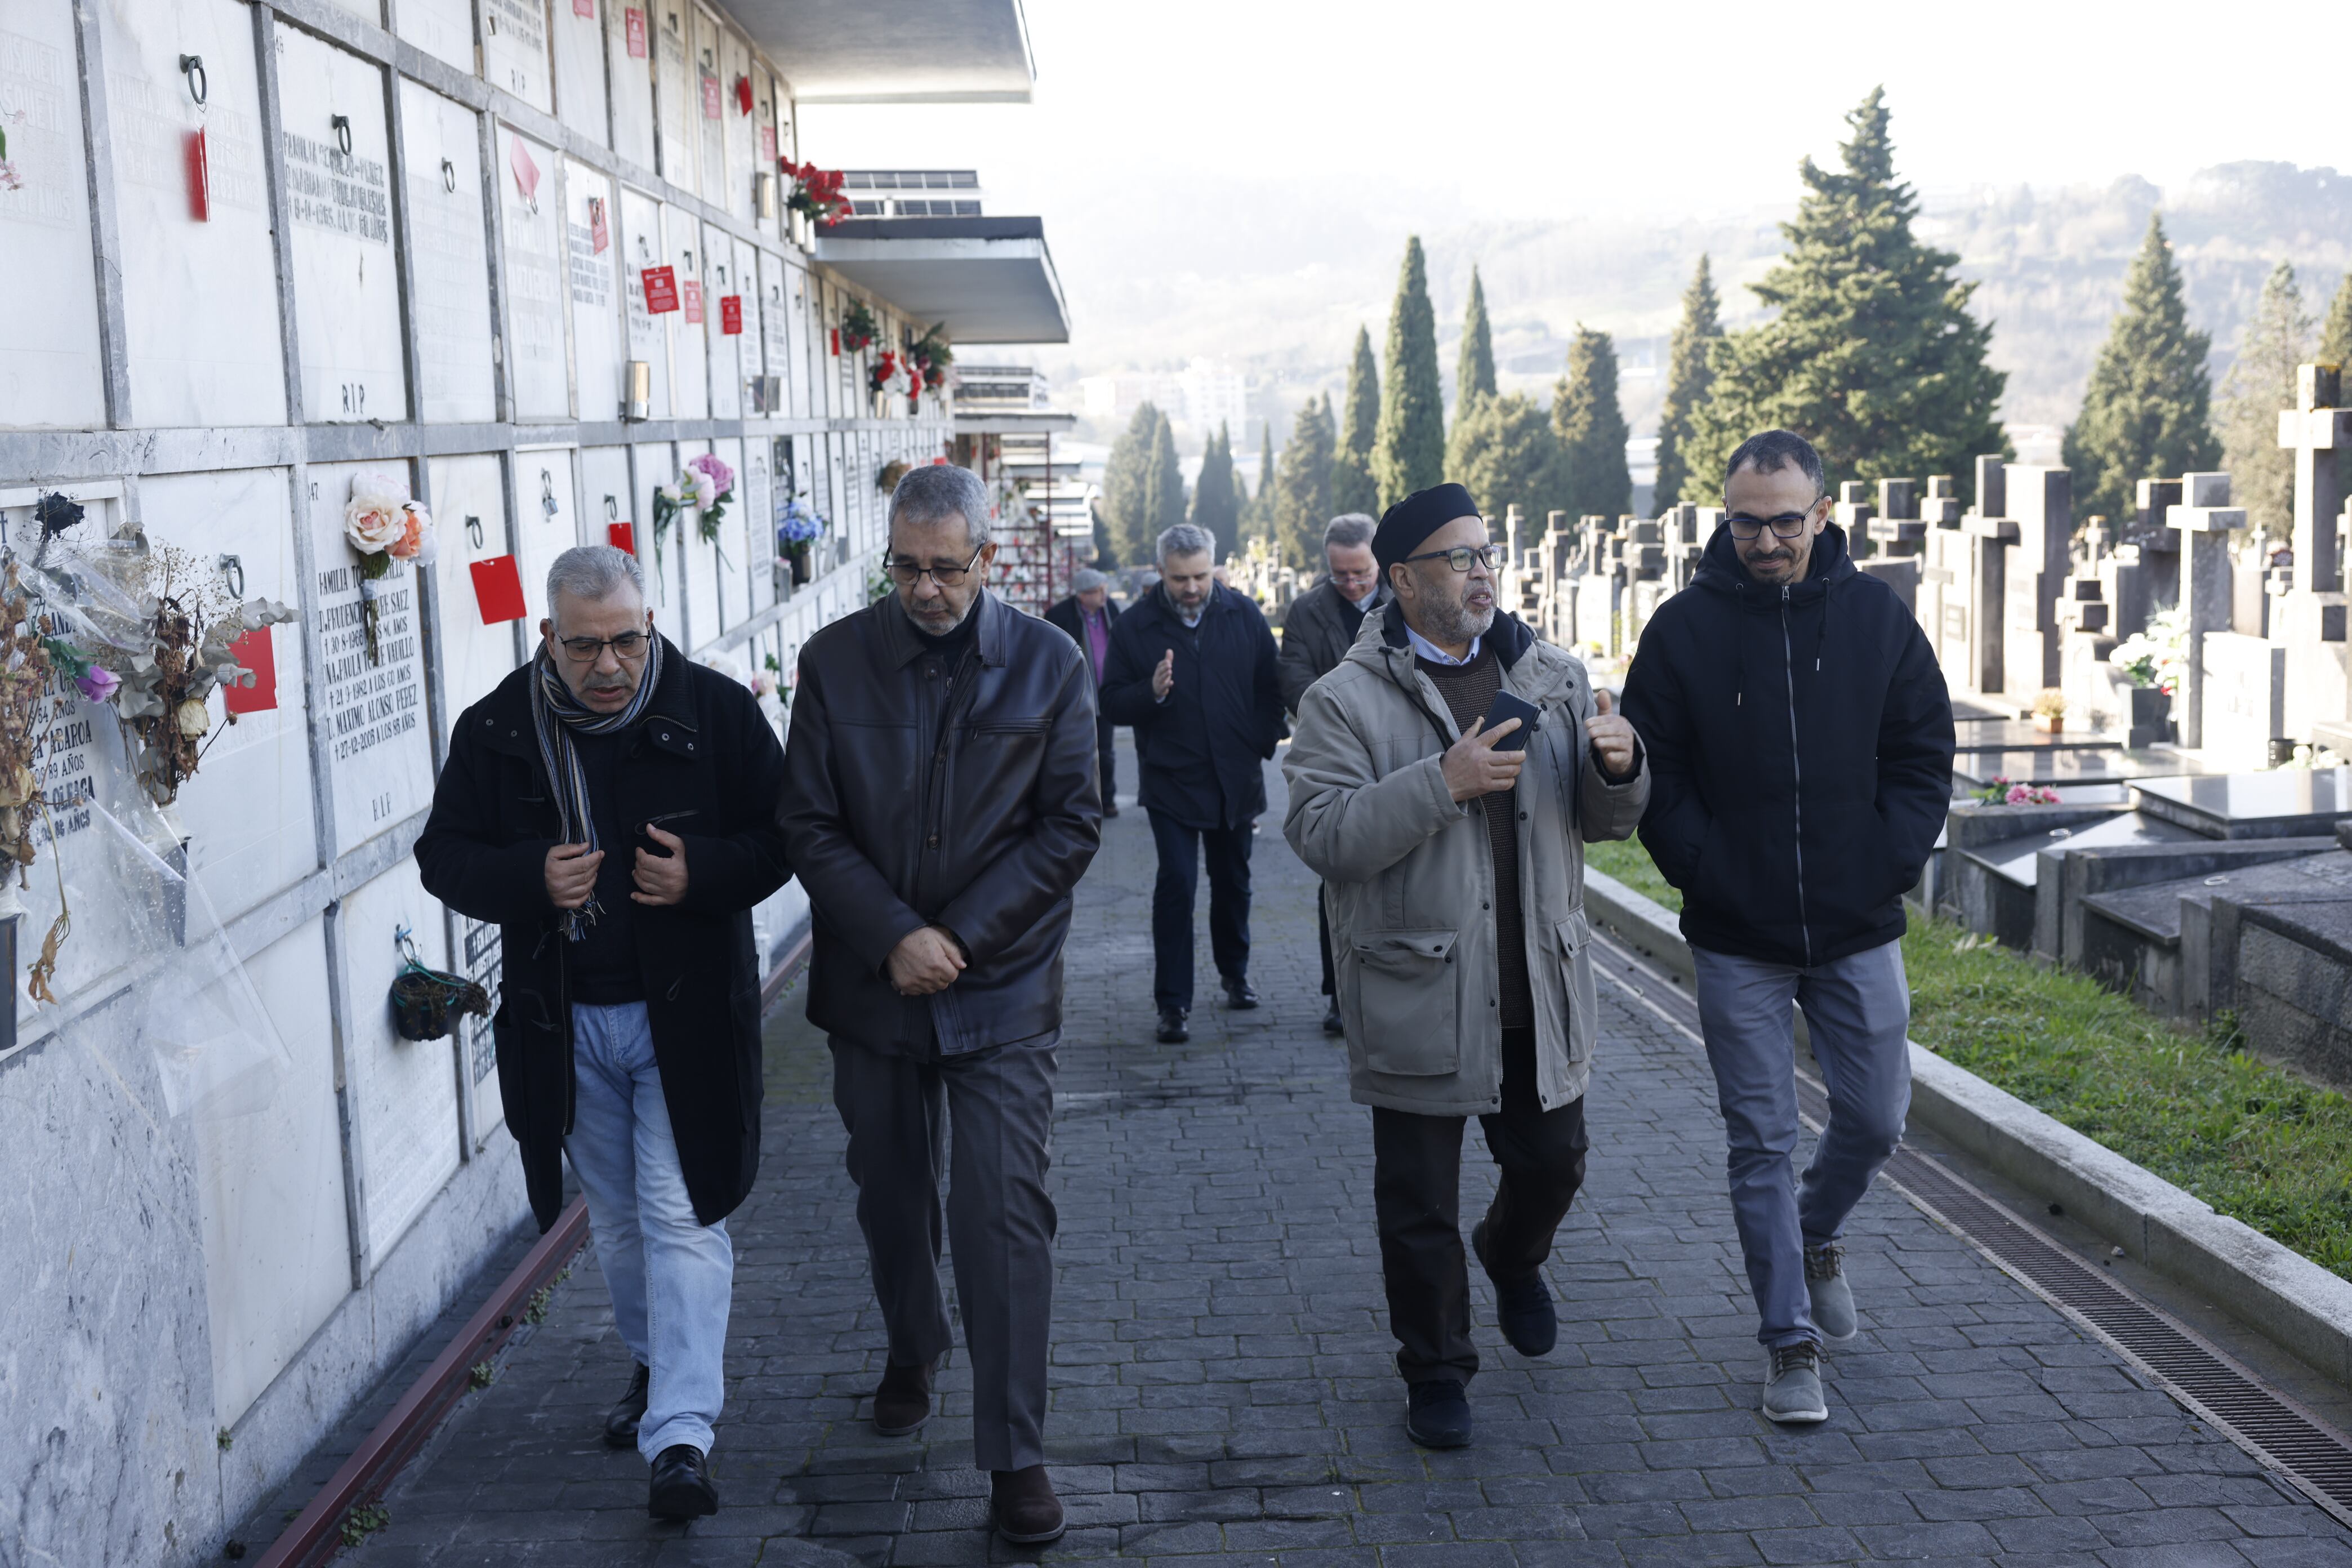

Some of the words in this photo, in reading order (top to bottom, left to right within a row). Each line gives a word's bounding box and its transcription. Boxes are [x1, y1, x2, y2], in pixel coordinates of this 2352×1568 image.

[510, 68, 526, 98] RIP
[283, 131, 318, 166] FAMILIA
[358, 186, 386, 217] IGLESIAS
[342, 382, 365, 415] RIP
[319, 568, 348, 596] FAMILIA
[390, 589, 409, 614] SAEZ
[386, 636, 415, 665] VADILLO
[369, 676, 373, 694] A
[374, 672, 386, 692] LOS
[336, 704, 365, 734] MAXIMO
[368, 693, 394, 724] ALONSO
[395, 684, 417, 711] PEREZ
[50, 719, 92, 754] ABAROA
[376, 726, 381, 744] A
[381, 721, 392, 742] LOS
[48, 761, 59, 780] 89
[62, 753, 84, 777] AÑOS
[372, 791, 391, 822] RIP
